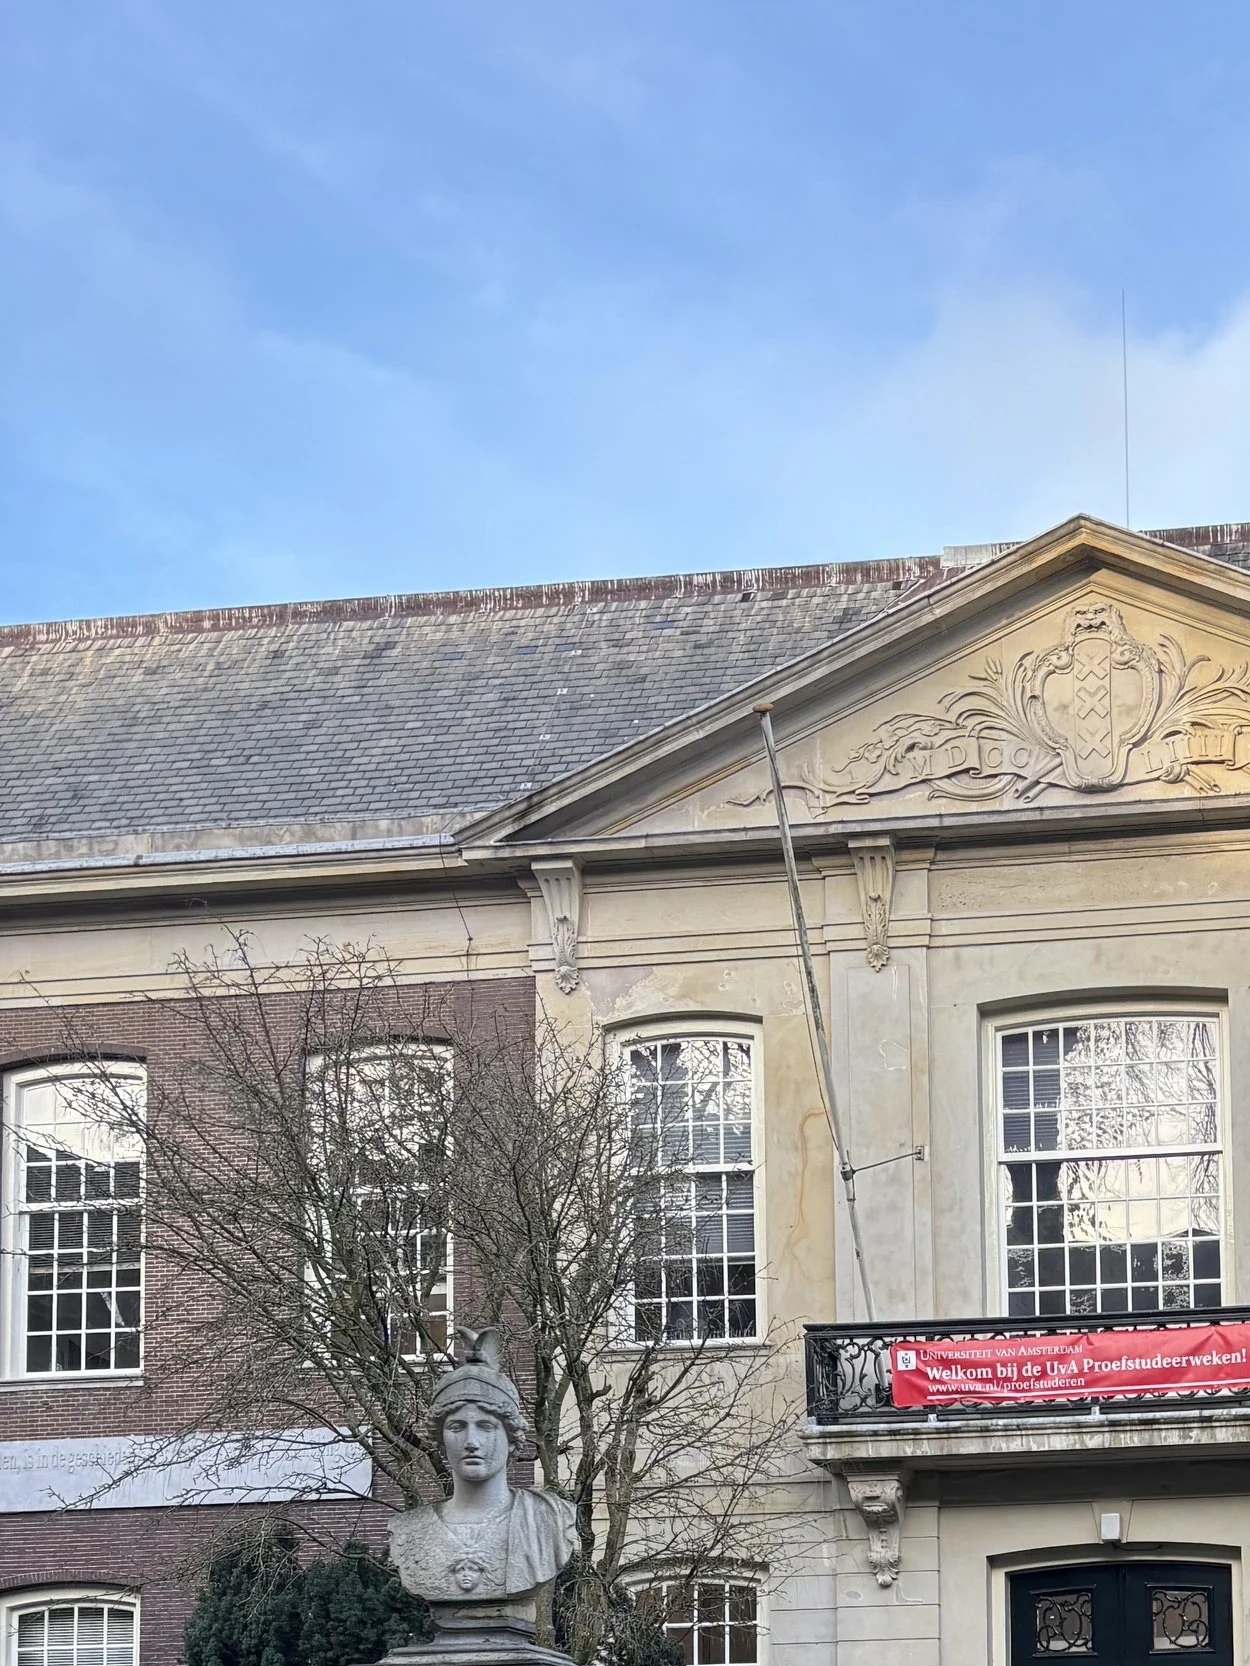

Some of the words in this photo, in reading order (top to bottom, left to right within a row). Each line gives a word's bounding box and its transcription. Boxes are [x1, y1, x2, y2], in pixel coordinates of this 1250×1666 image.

[919, 1349, 993, 1361] UNIVERSITEIT
[995, 1348, 1016, 1357] VAN
[1018, 1344, 1083, 1356] AMSTERDAM
[926, 1364, 992, 1381] Welkom
[996, 1362, 1018, 1380] bij
[1022, 1361, 1042, 1377] de
[1046, 1361, 1079, 1374] UvA
[1083, 1348, 1247, 1373] Proefstudeerweken!
[928, 1376, 1085, 1393] www.uva.nl/proefstuderen
[0, 1456, 20, 1475] en,
[23, 1448, 33, 1470] is
[36, 1448, 48, 1469] in
[52, 1445, 65, 1468] de
